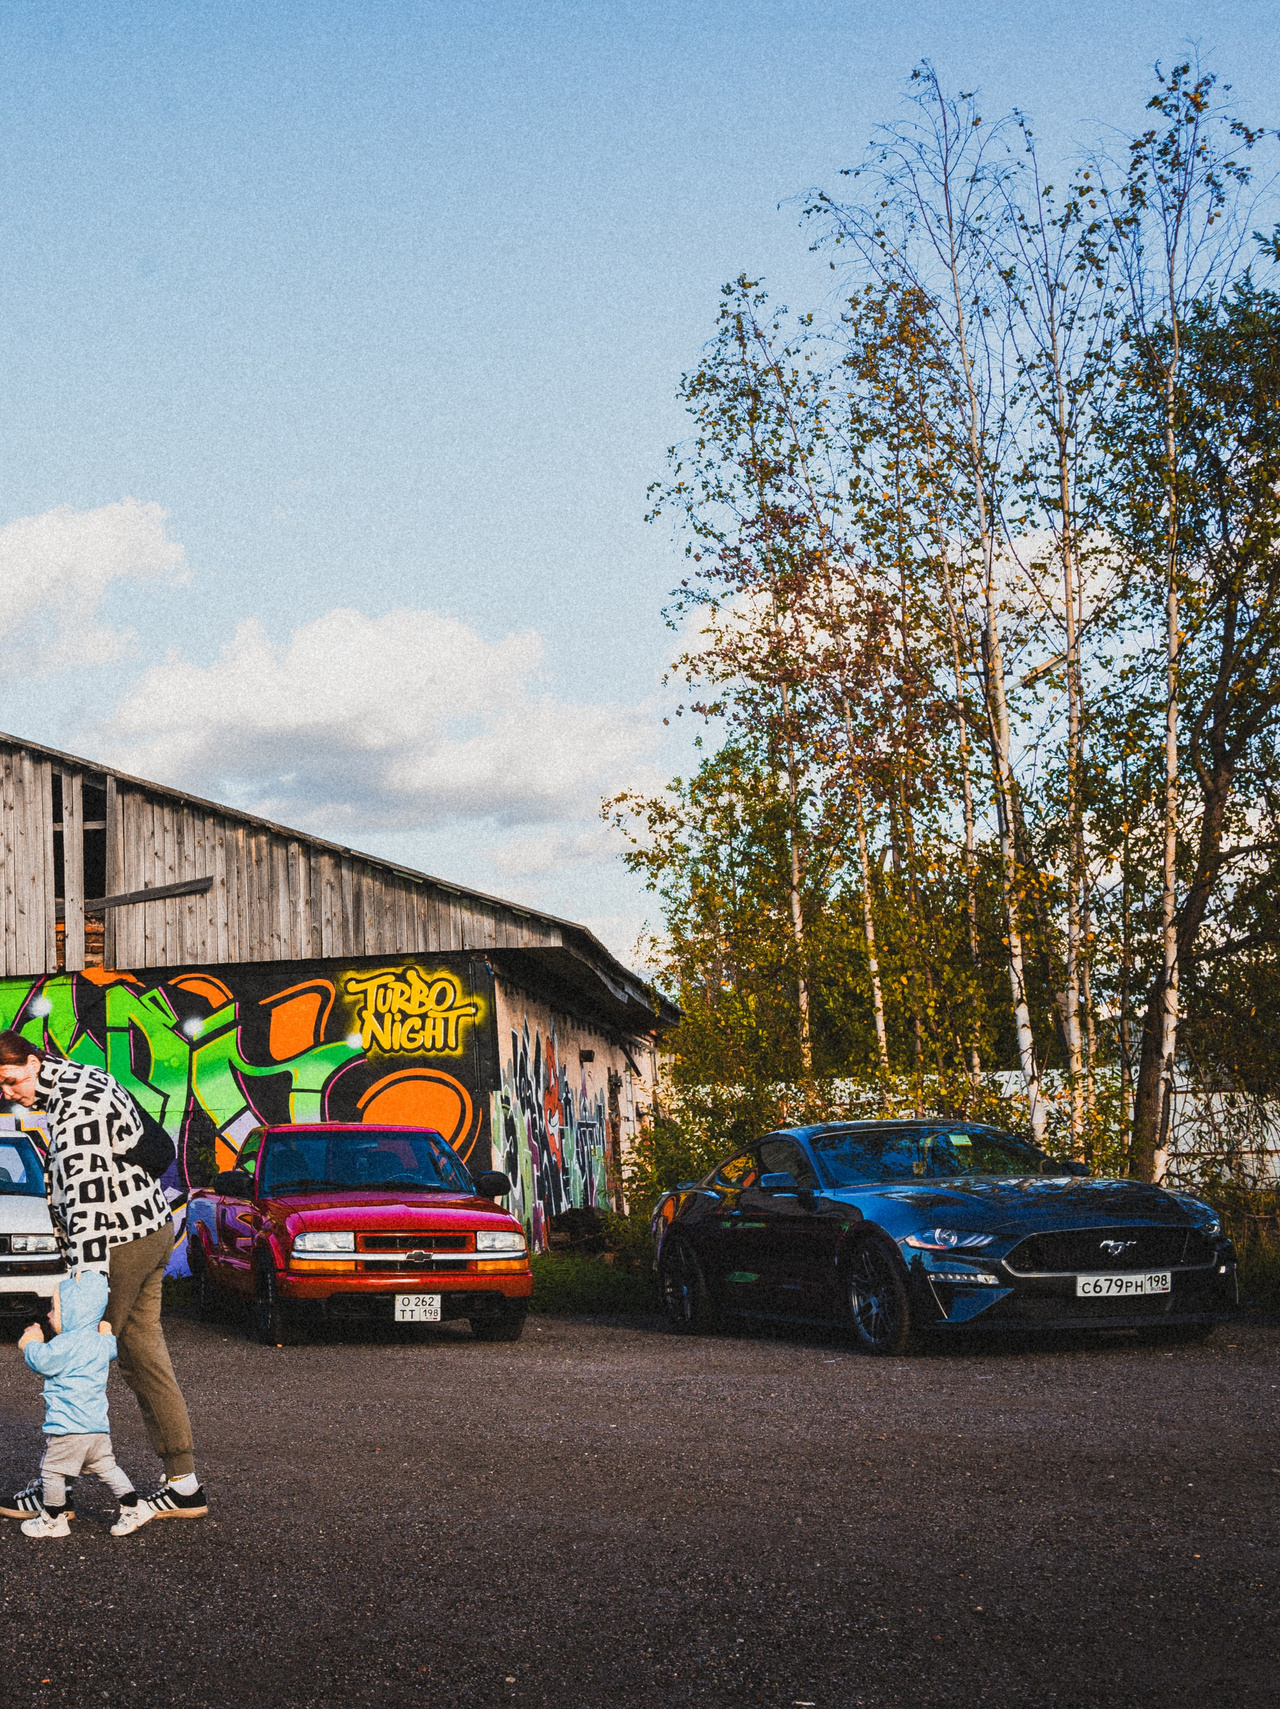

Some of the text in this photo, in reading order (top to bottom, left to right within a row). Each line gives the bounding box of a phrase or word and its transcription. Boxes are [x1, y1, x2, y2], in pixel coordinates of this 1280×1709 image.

[345, 967, 455, 1015] TURBO
[1081, 1274, 1168, 1294] С679РН 198
[414, 1296, 435, 1307] 262
[400, 1308, 439, 1320] ТТ 198
